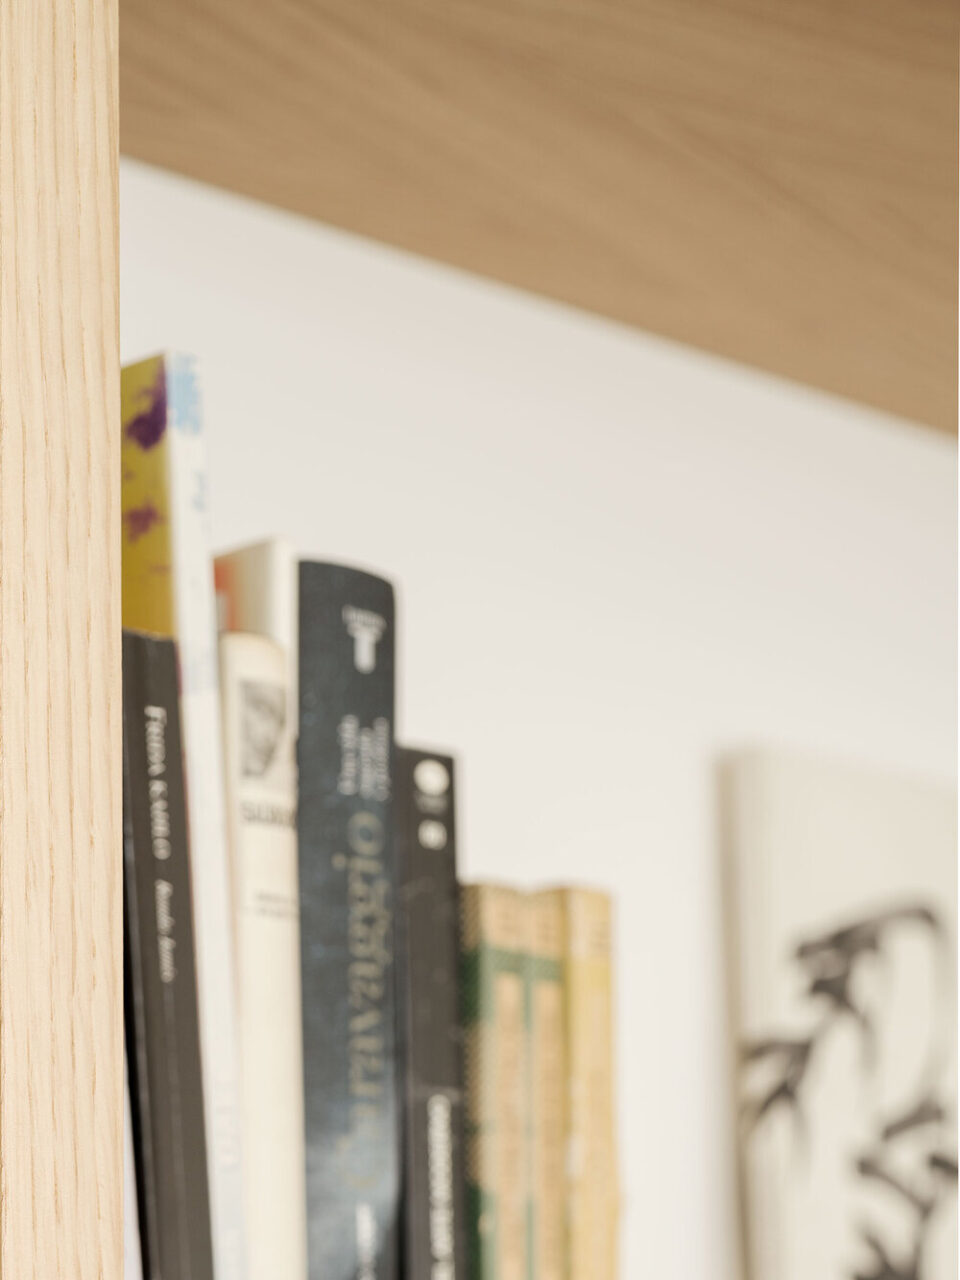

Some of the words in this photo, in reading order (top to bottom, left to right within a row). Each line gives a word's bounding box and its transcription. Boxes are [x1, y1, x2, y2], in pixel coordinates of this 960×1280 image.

[144, 705, 168, 776] FRIDA
[148, 779, 171, 860] KAHLO
[331, 810, 393, 1191] Caravaggio
